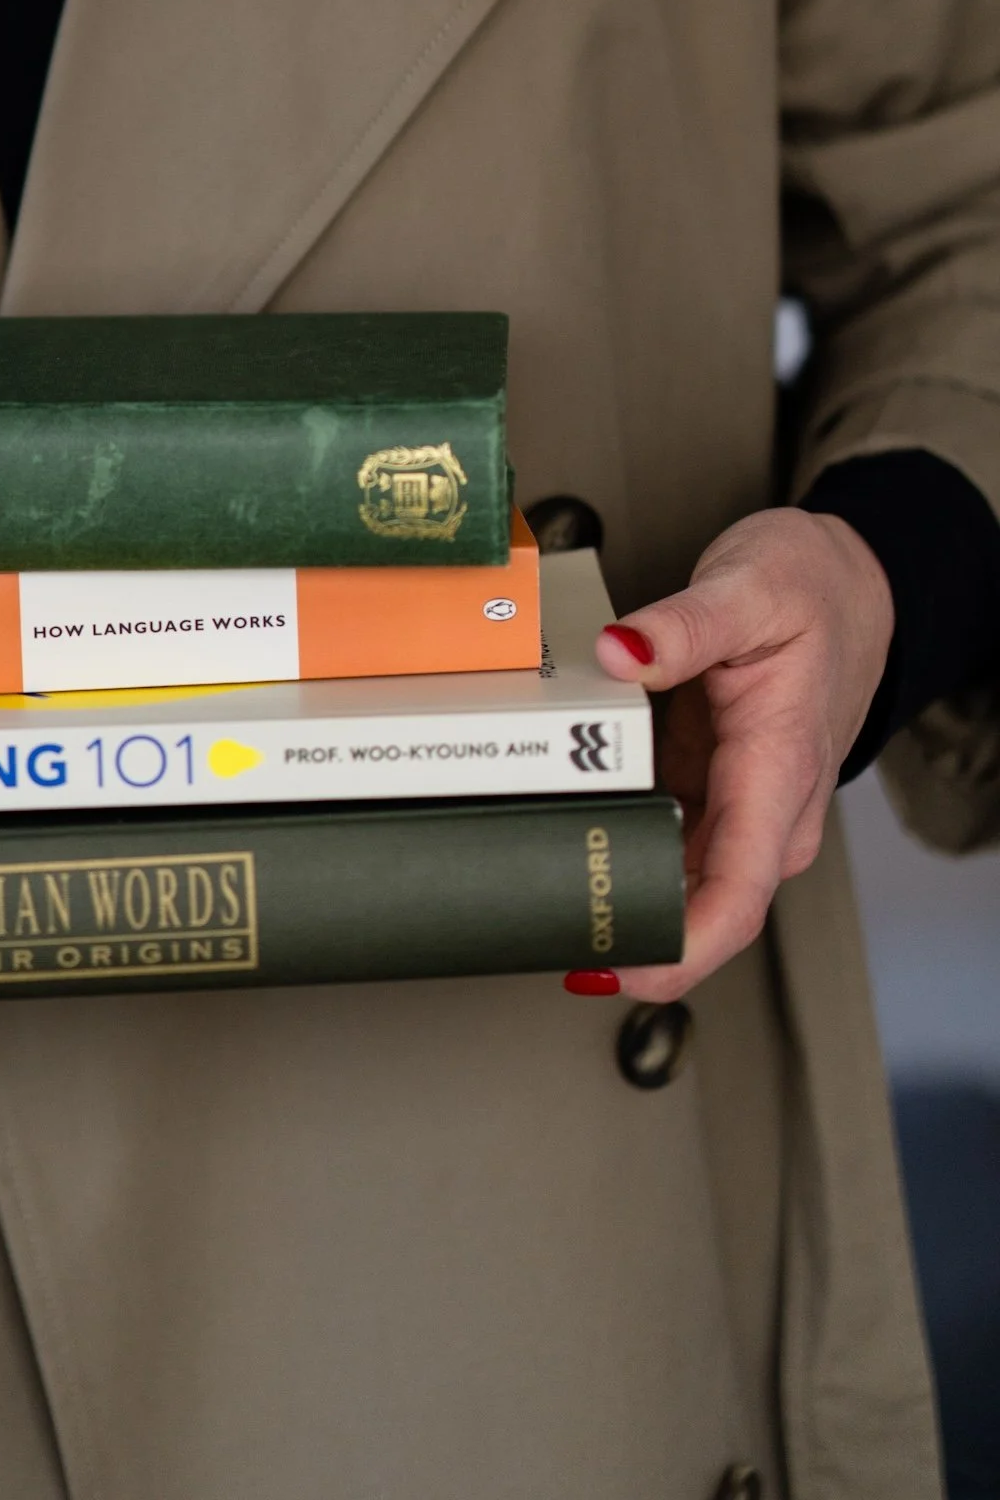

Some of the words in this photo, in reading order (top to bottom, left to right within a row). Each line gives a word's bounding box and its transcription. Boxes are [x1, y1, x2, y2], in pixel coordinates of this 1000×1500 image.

[33, 625, 84, 639] HOW
[92, 618, 205, 636] LANGUAGE
[212, 614, 286, 629] WORKS
[85, 734, 194, 788] 101
[284, 747, 344, 764] PROF.
[350, 743, 499, 762] WOO-KYOUNG
[505, 741, 549, 757] AHN
[88, 865, 241, 929] WORDS
[586, 826, 614, 953] OXFORD
[57, 938, 243, 967] ORIGINS
